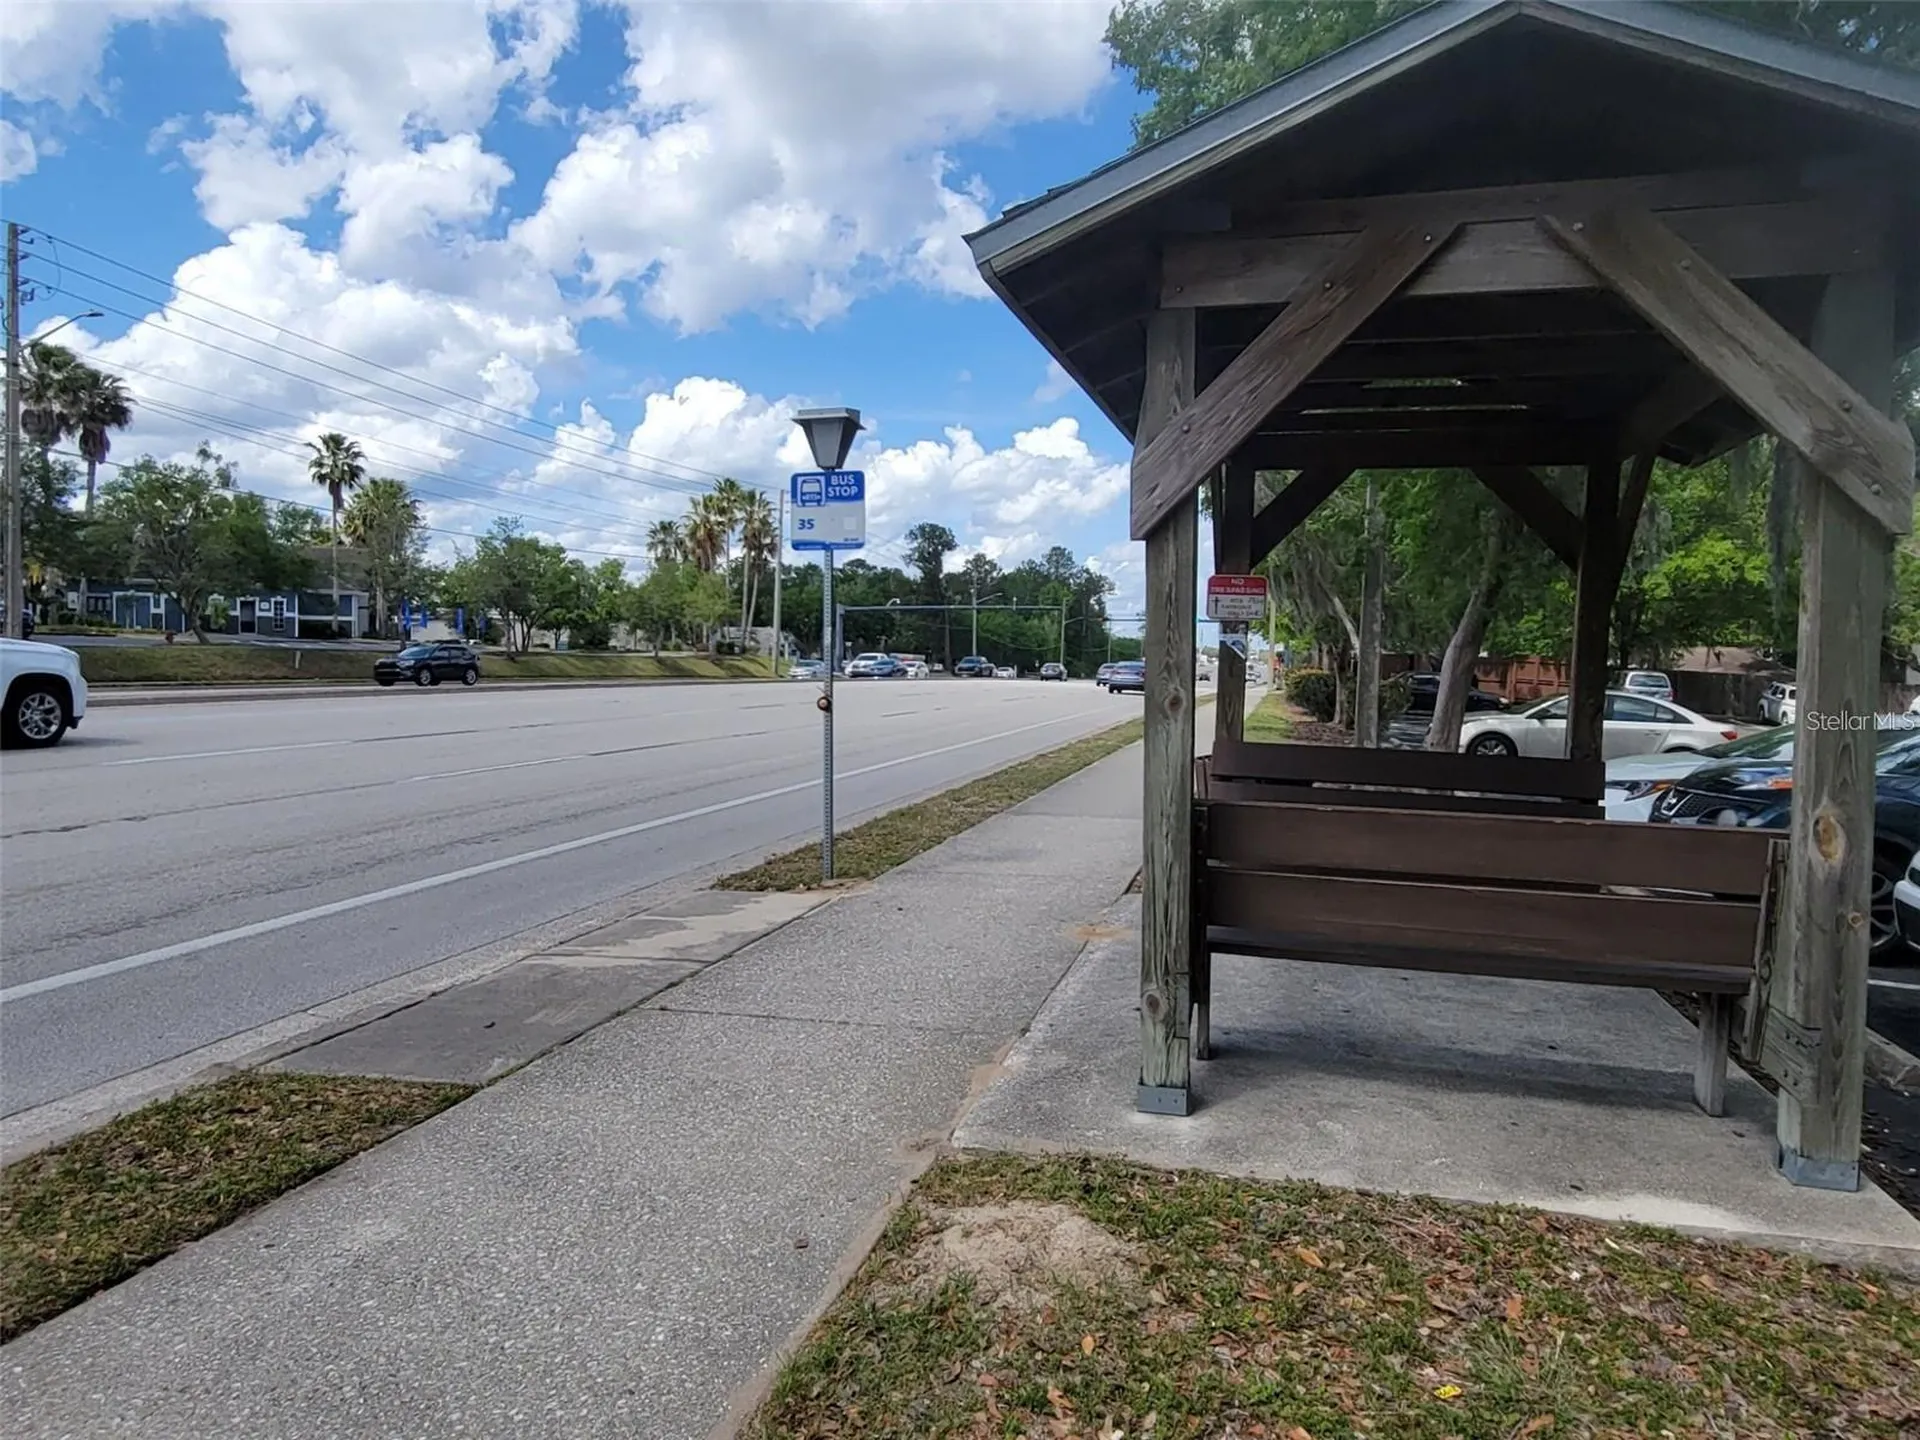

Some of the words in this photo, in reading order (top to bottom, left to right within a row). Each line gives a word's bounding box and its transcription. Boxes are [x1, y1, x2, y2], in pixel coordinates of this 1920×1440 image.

[830, 475, 855, 485] BUS
[827, 487, 859, 497] STOP
[797, 518, 815, 530] 35
